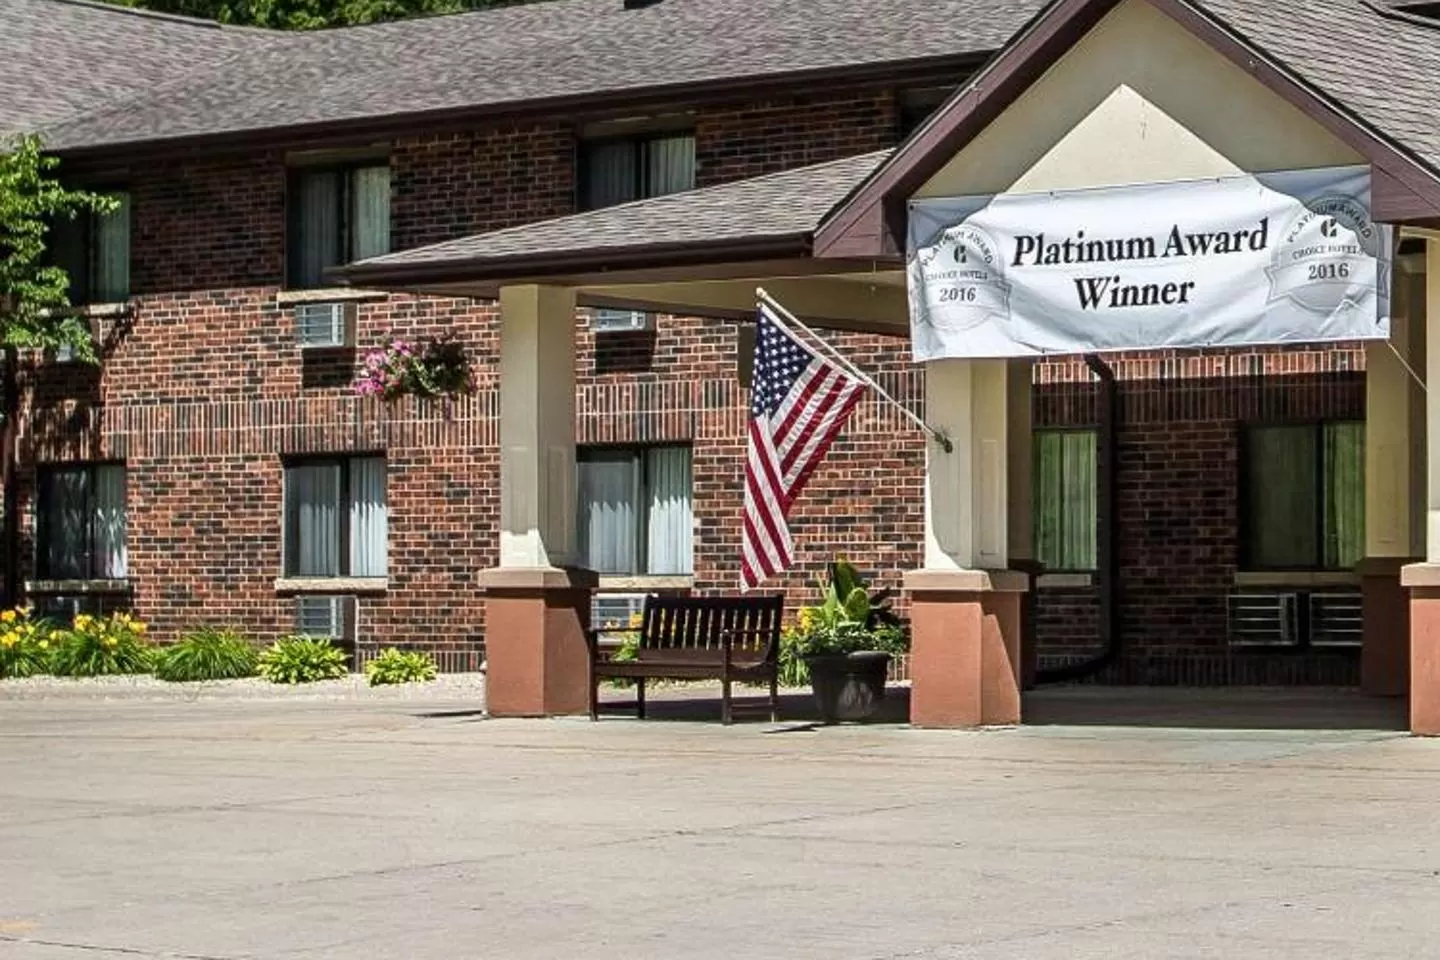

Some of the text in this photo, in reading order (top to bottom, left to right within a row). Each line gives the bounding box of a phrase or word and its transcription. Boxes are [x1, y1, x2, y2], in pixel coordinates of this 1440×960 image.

[1010, 216, 1269, 266] Platinum Award
[1308, 263, 1349, 280] 2016
[939, 287, 977, 302] 2016
[1074, 275, 1195, 310] Winner
